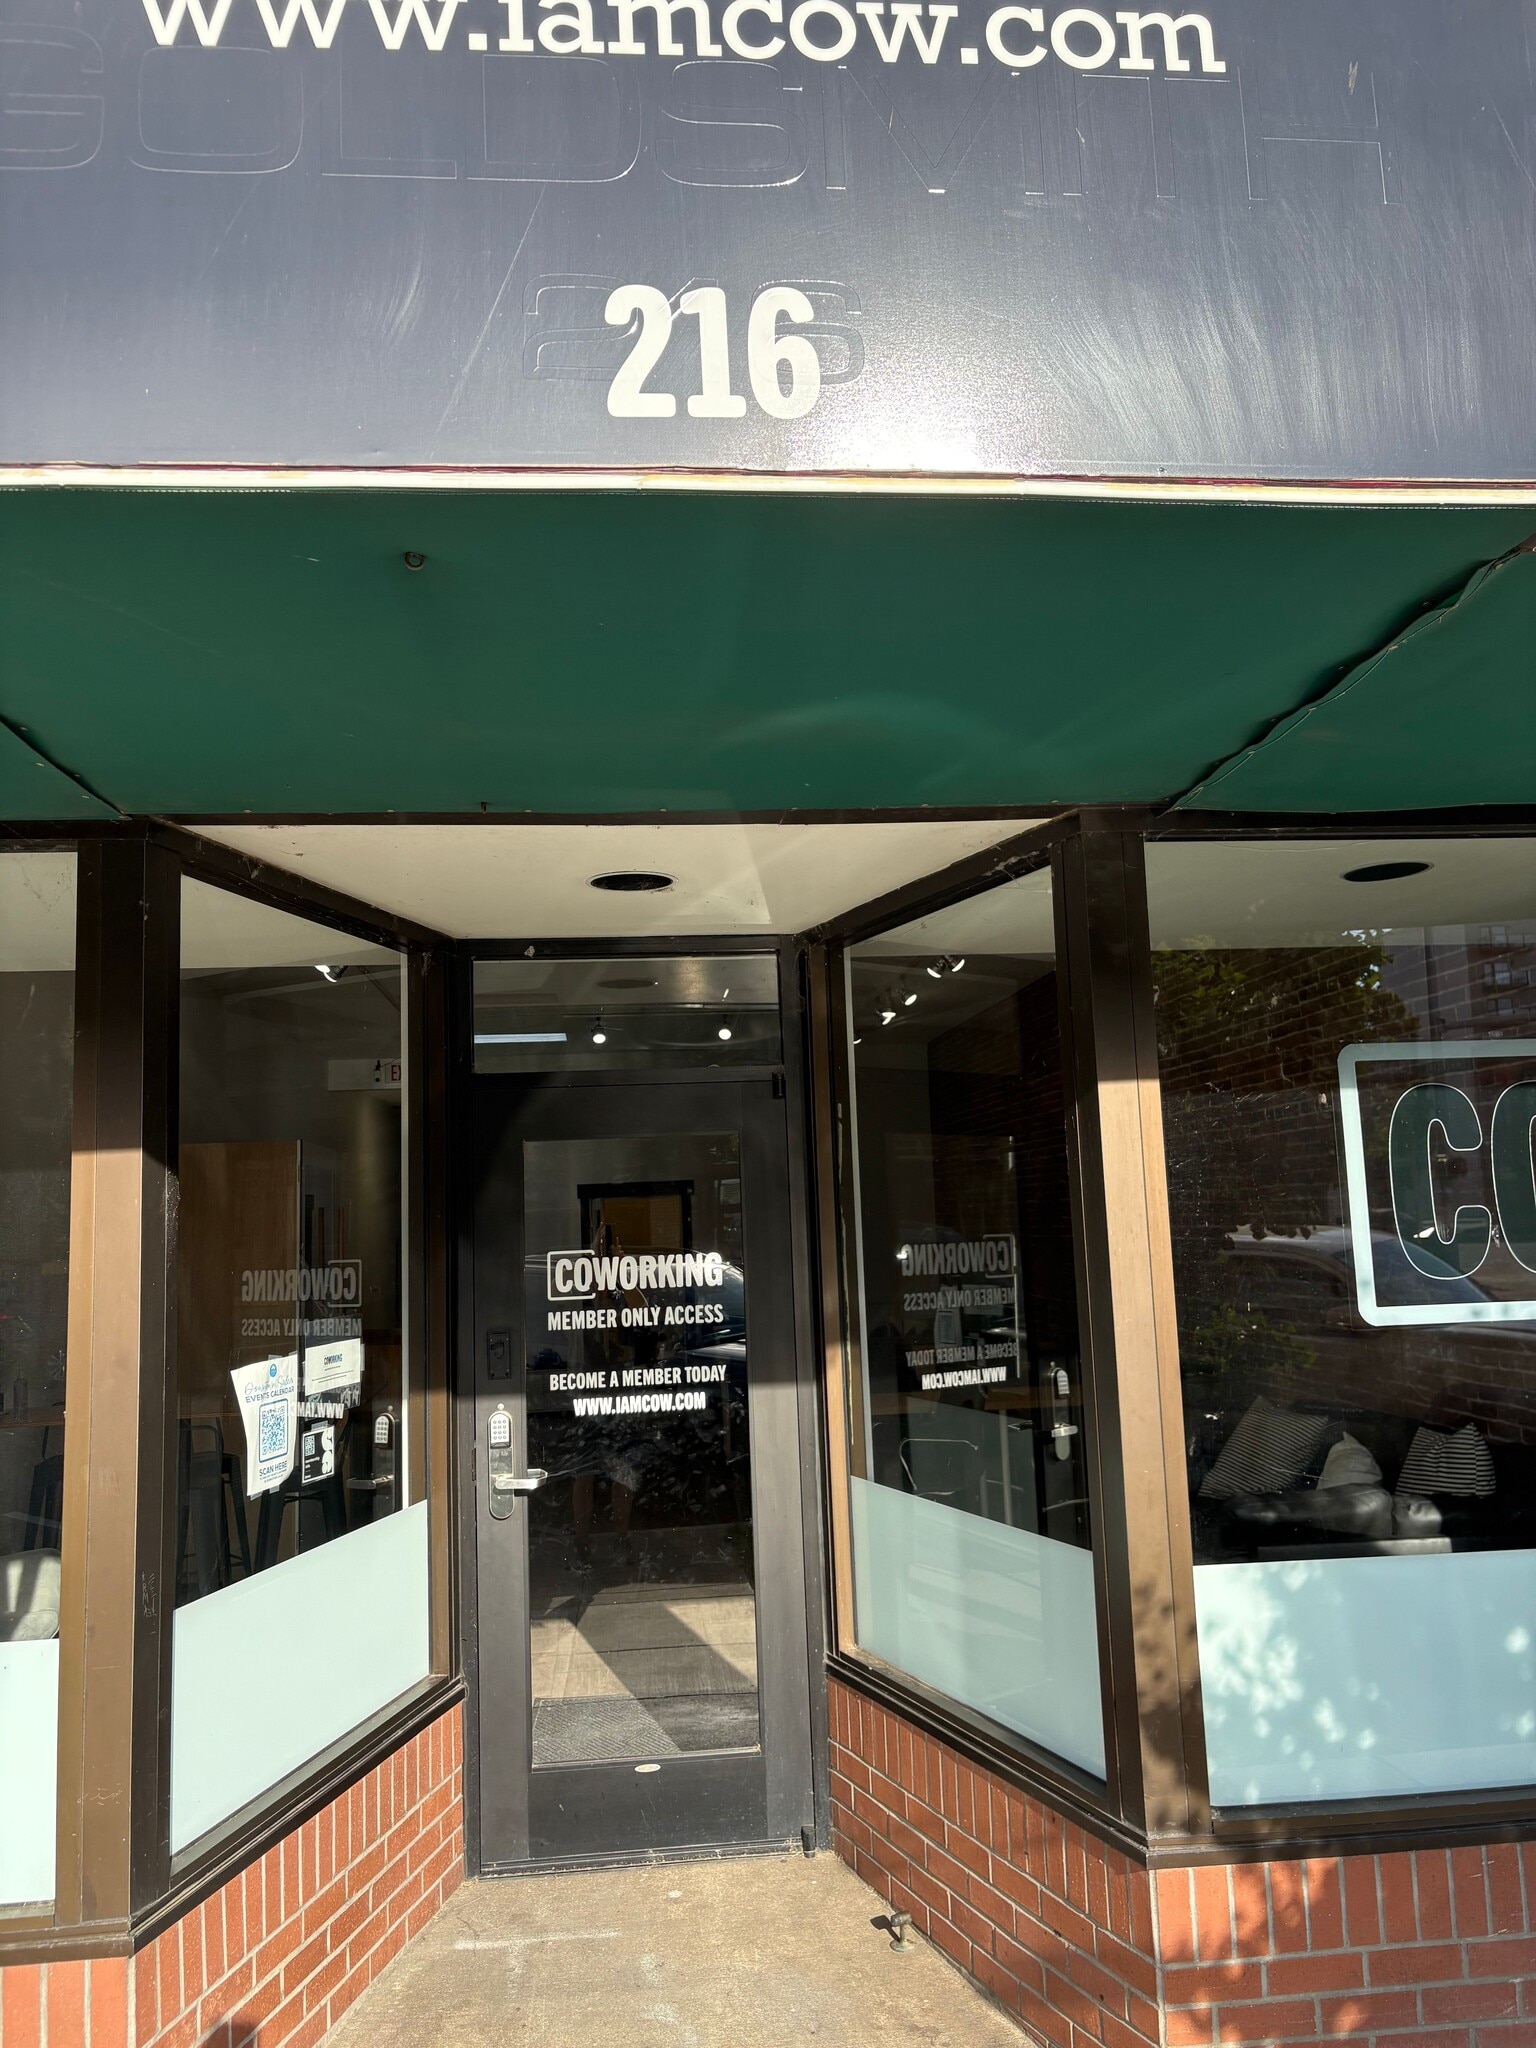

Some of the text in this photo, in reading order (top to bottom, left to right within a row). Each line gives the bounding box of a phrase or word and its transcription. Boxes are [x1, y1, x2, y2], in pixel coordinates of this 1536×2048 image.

[140, 0, 1227, 73] www.iamcow.com
[604, 284, 821, 419] 216
[554, 1252, 723, 1293] COWORKING
[547, 1303, 724, 1331] MEMBER ONLY ACCESS
[549, 1364, 727, 1391] BECOME A MEMBER TODAY
[573, 1392, 706, 1417] WWW.IAMCOW.COM
